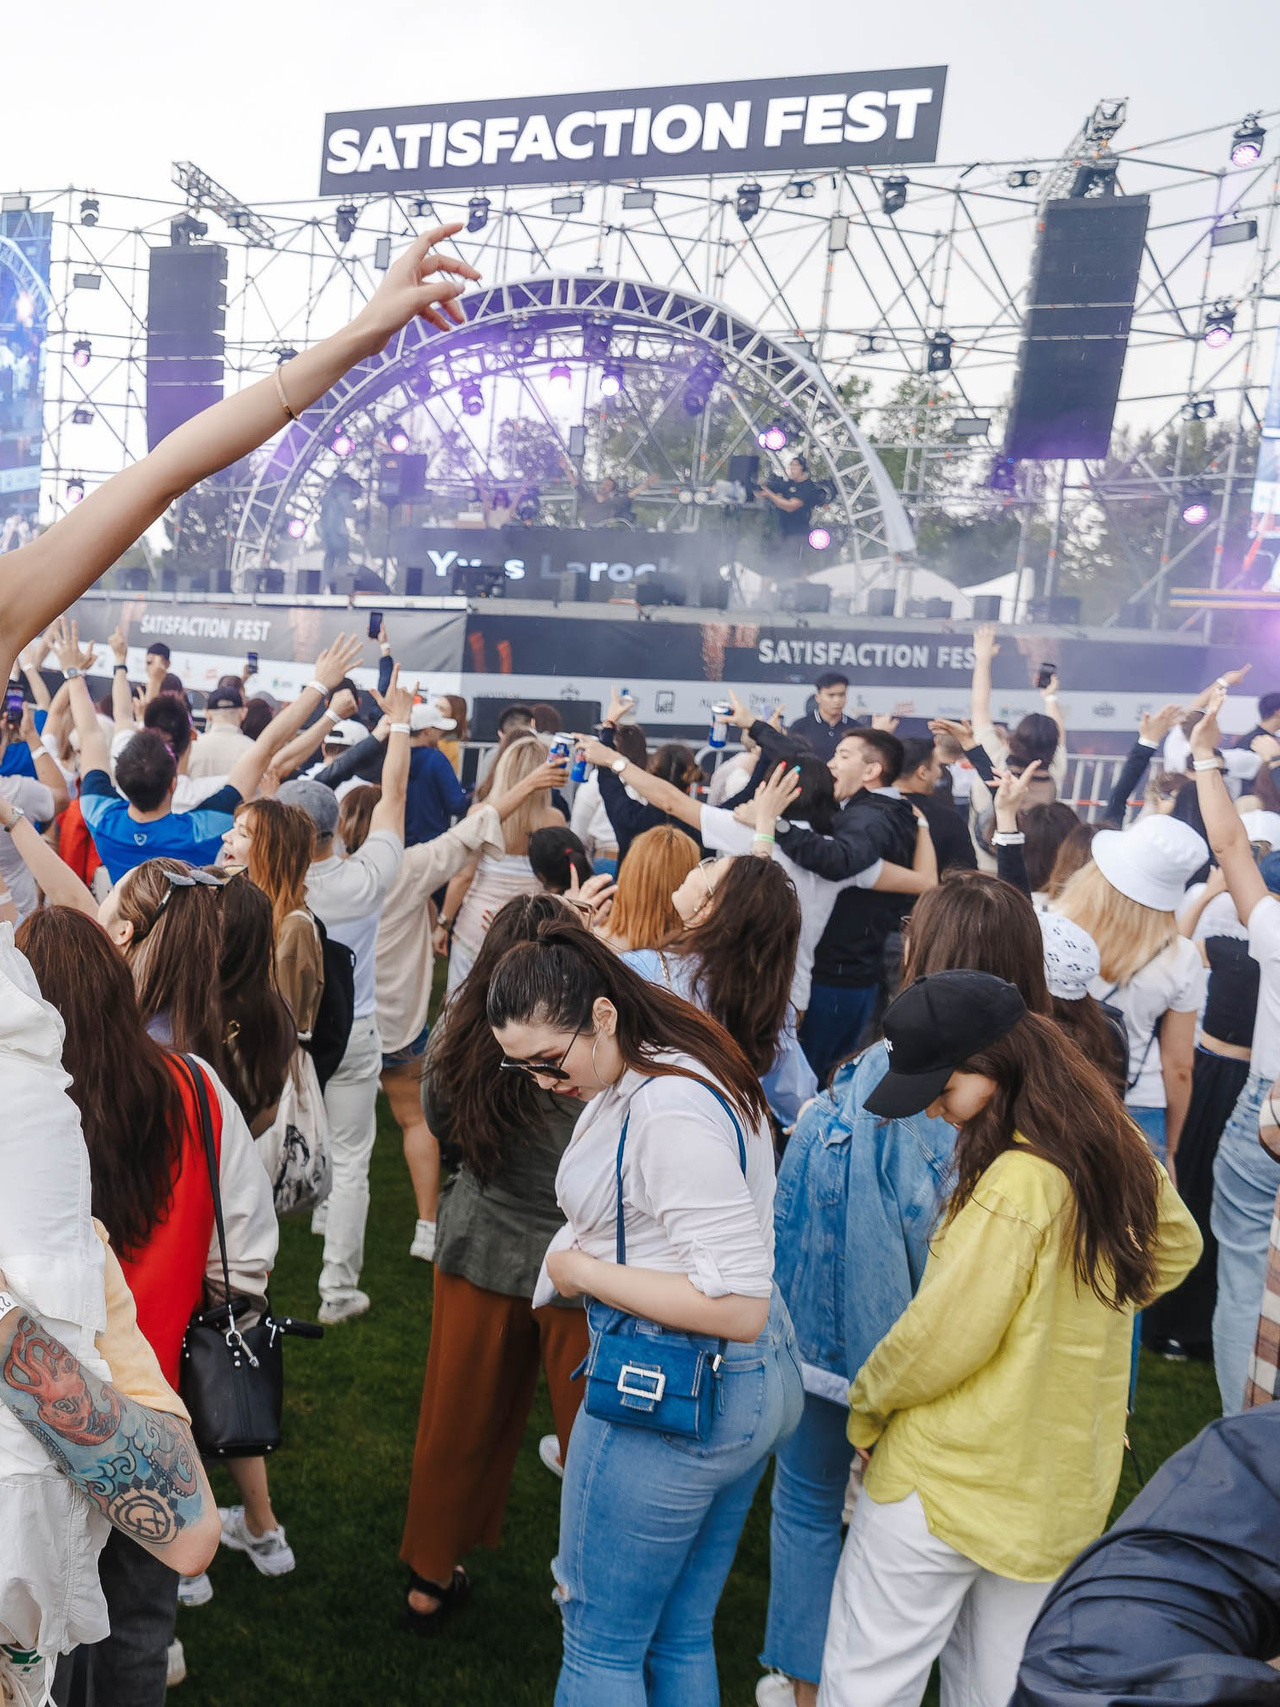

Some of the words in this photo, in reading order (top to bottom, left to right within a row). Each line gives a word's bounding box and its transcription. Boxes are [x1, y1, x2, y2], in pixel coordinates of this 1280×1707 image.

[326, 101, 751, 175] SATISFACTION
[764, 88, 933, 147] FEST
[427, 550, 526, 580] Ys
[140, 614, 231, 639] SATISFACTION
[233, 619, 272, 642] FEST
[758, 638, 929, 668] SATISFACTION
[937, 646, 977, 670] FES
